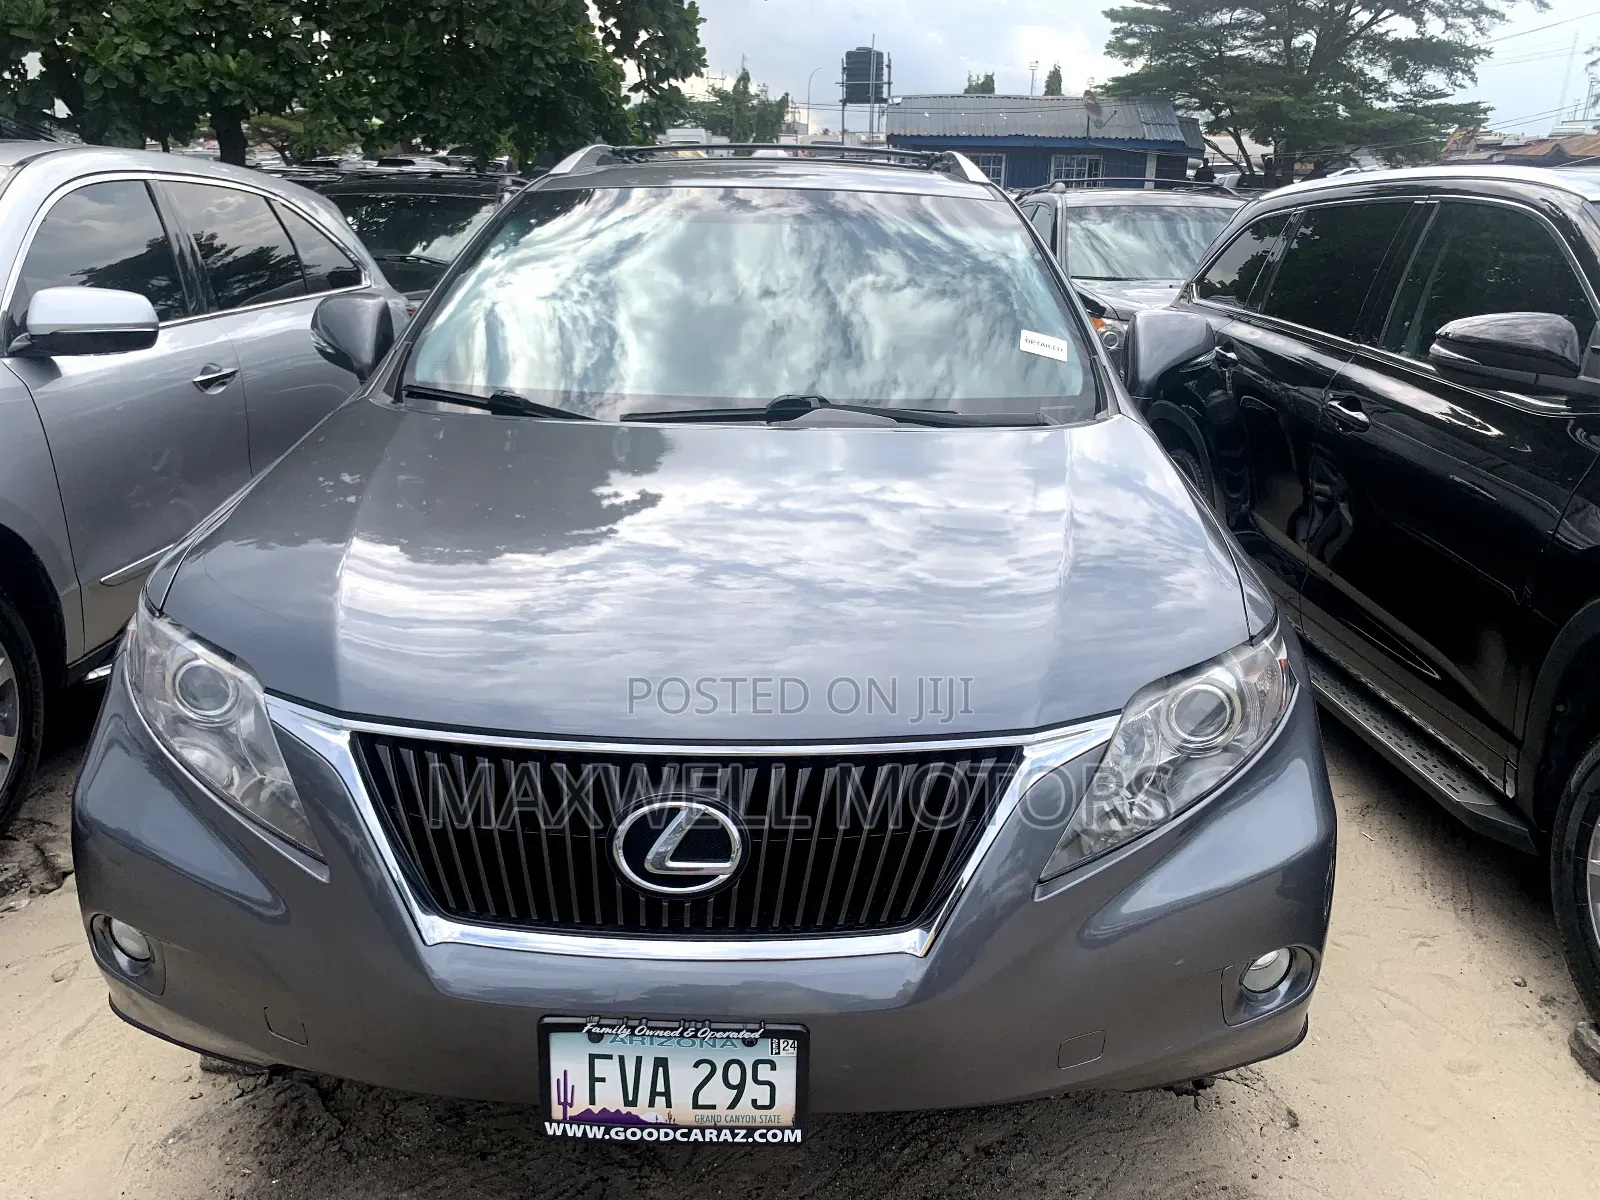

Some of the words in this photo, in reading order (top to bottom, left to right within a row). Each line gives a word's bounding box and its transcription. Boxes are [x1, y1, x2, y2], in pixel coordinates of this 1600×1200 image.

[582, 1022, 631, 1038] Family
[634, 1025, 680, 1038] Owned
[683, 1028, 695, 1038] &
[697, 1028, 764, 1041] Operated
[608, 1035, 740, 1049] ARIZONA
[782, 1039, 797, 1051] 24
[588, 1053, 673, 1109] FVA
[691, 1058, 777, 1111] 29S
[694, 1114, 723, 1123] GRAND
[725, 1115, 757, 1124] CANYON
[759, 1115, 782, 1124] STATE
[544, 1121, 802, 1143] WWW.GOODCARAZ.COM
